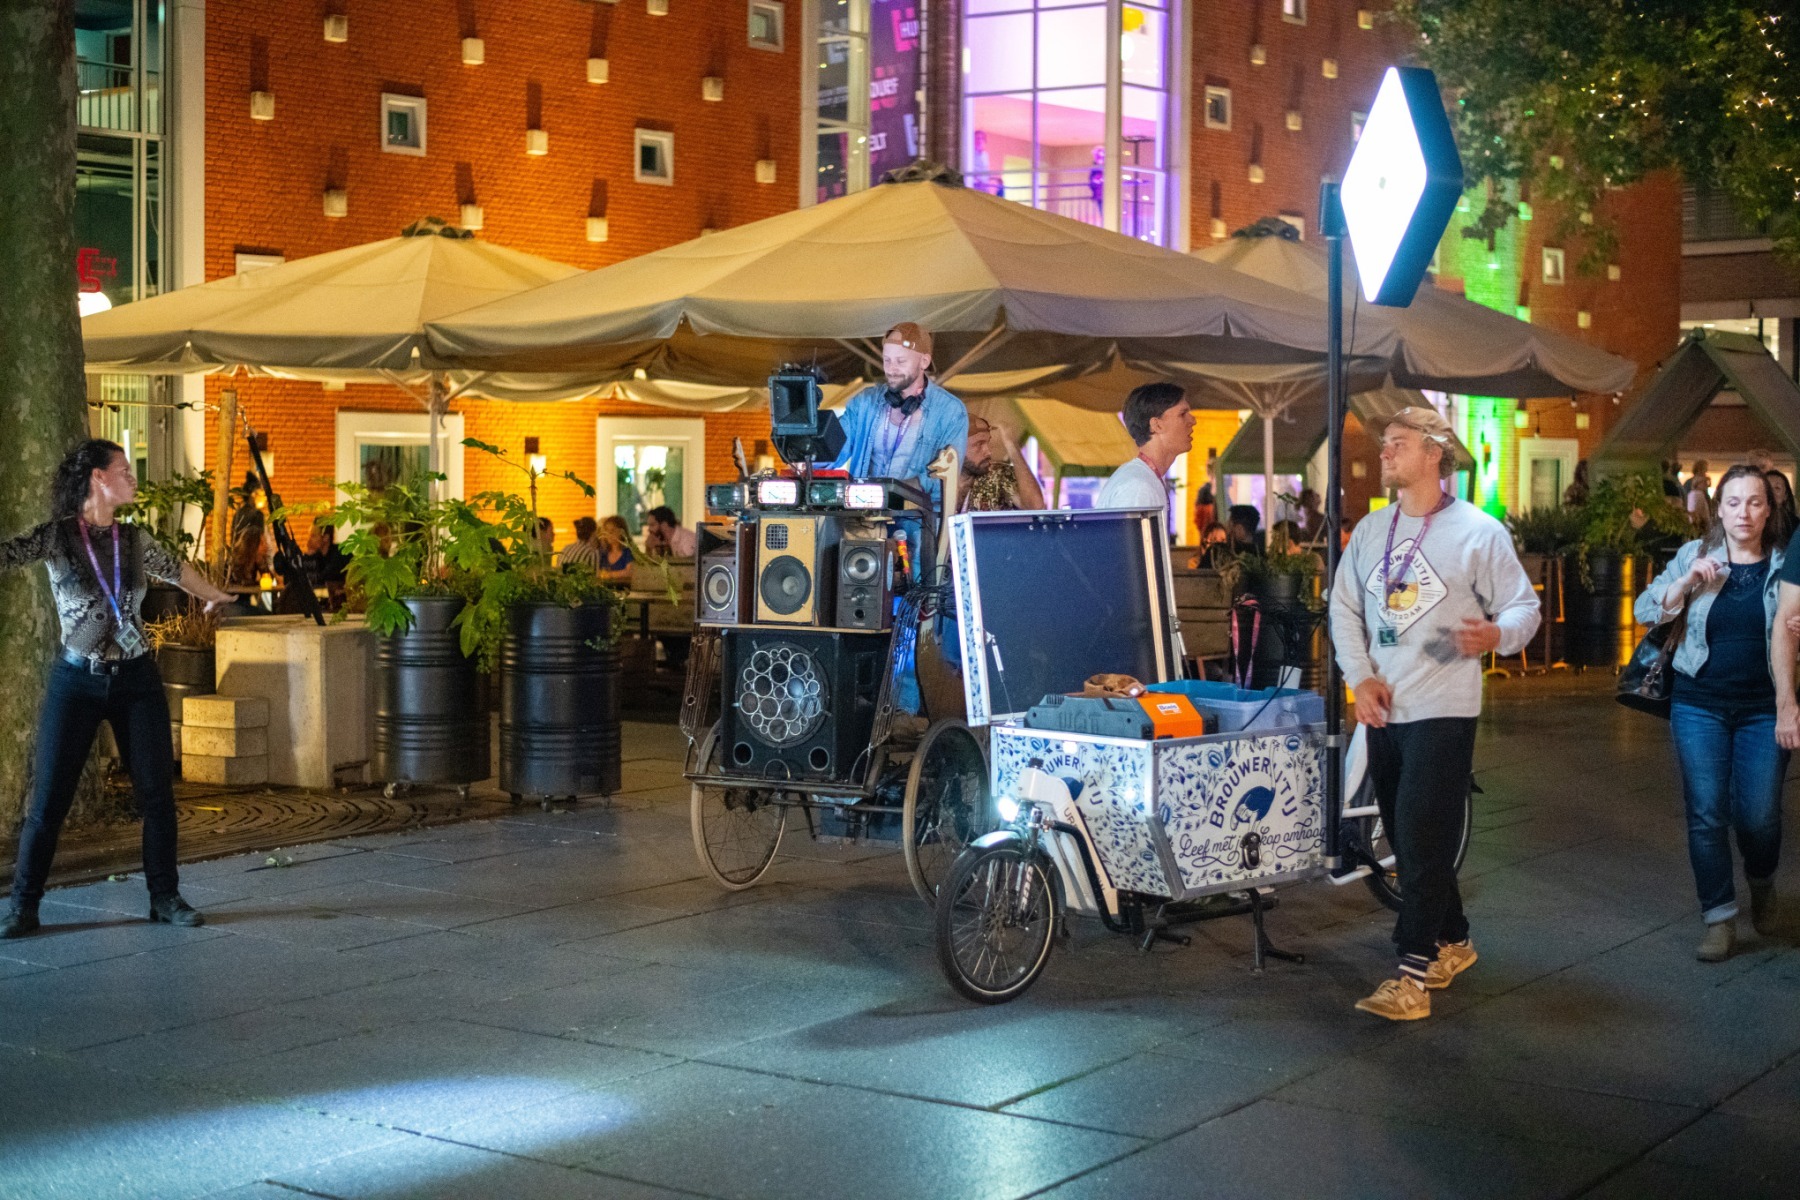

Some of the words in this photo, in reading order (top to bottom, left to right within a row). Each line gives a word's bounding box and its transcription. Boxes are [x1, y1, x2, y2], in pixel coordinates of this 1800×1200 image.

[1281, 795, 1298, 817] IJ
[1179, 832, 1211, 862] Leef
[1212, 834, 1237, 853] met
[1259, 826, 1282, 850] kop
